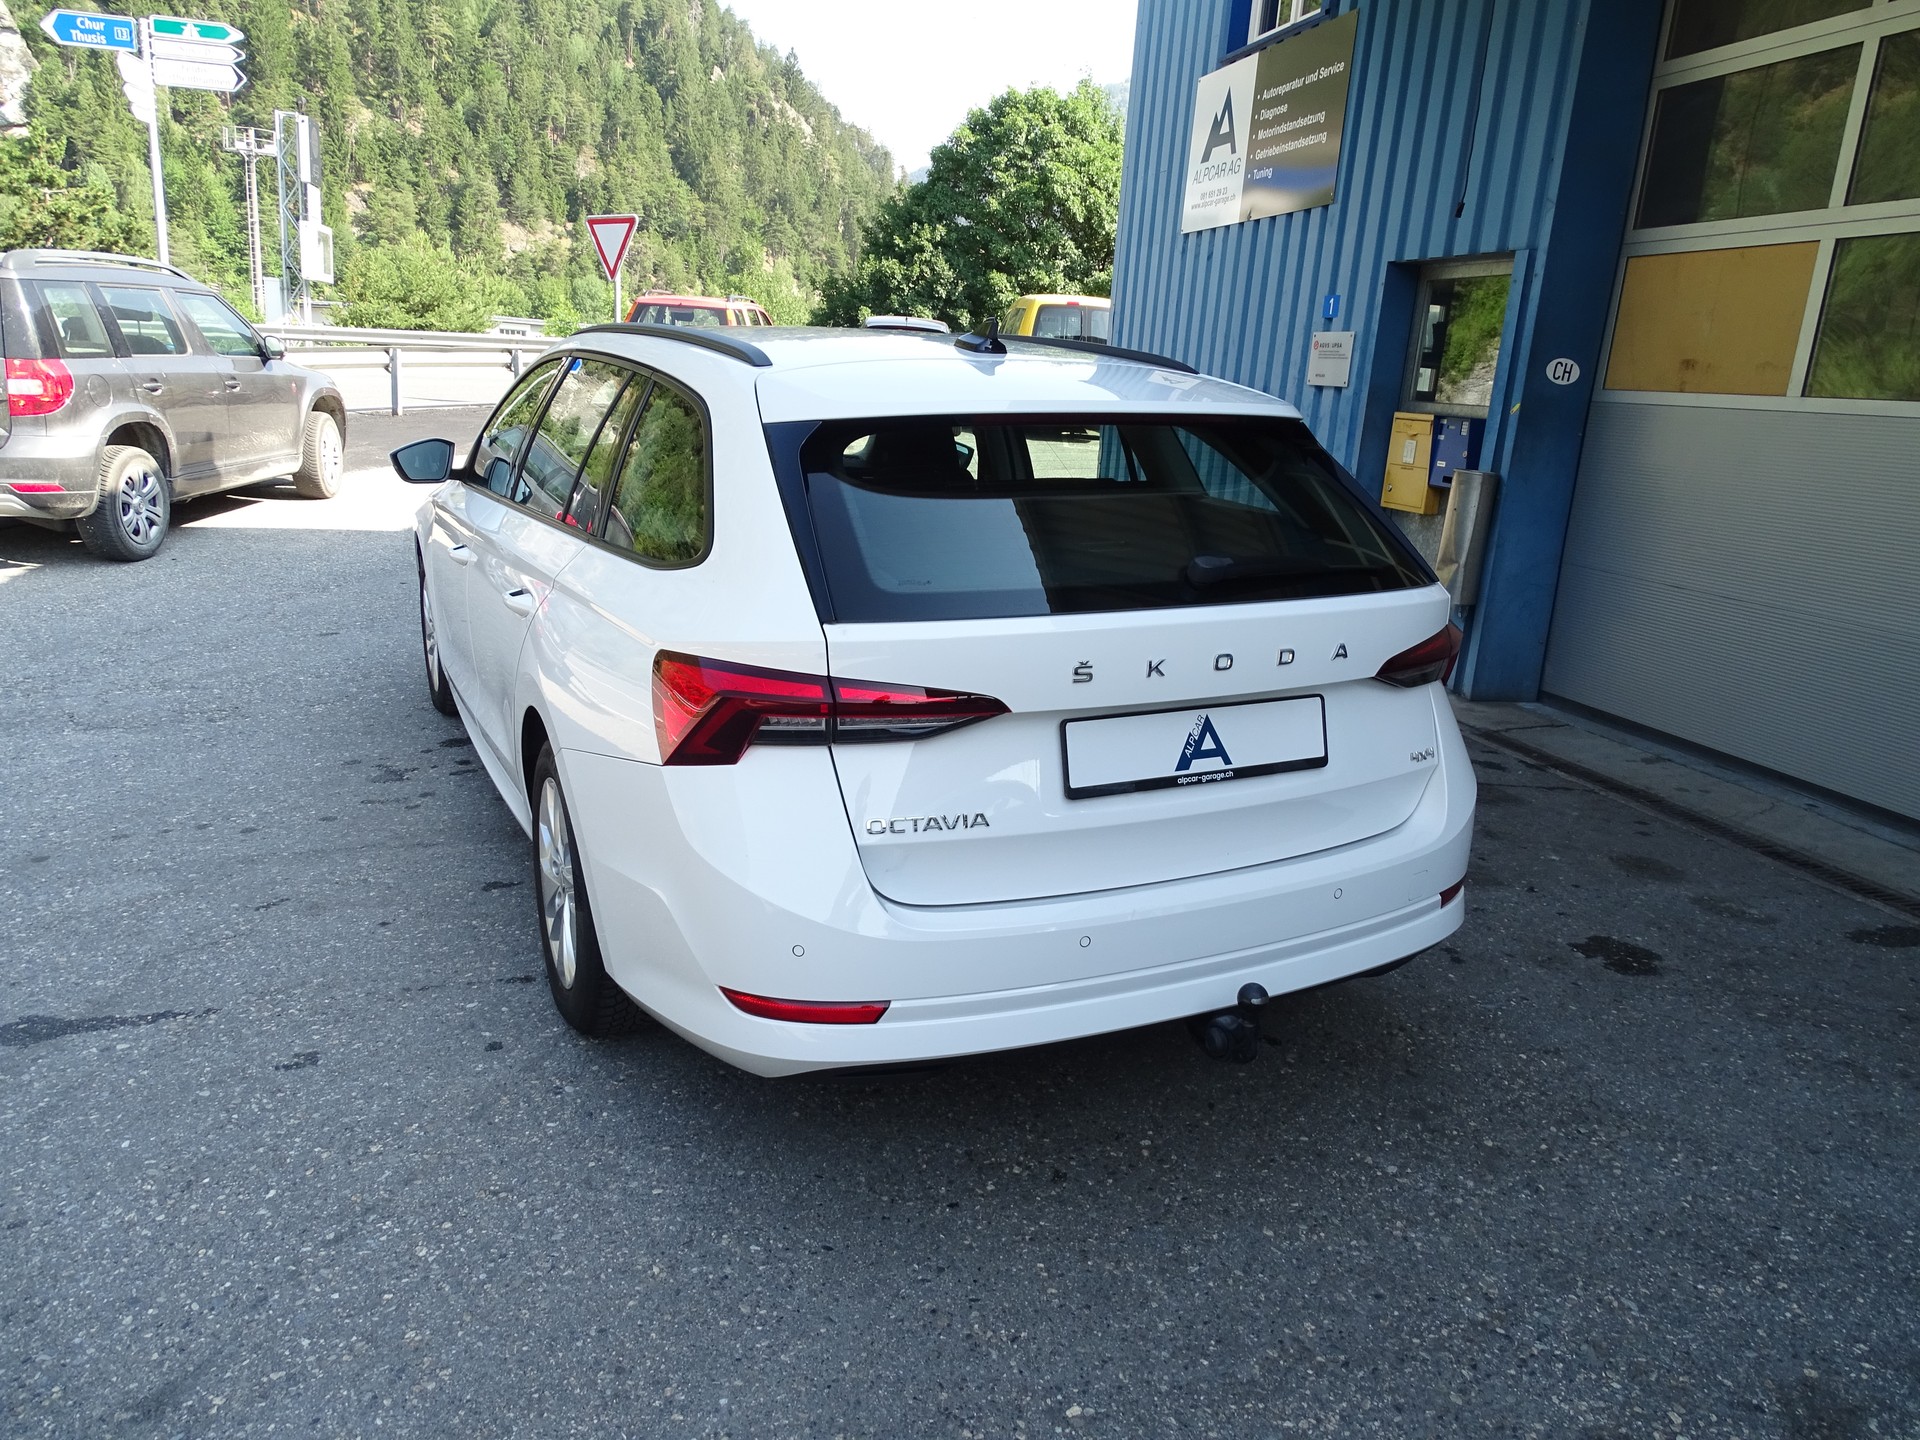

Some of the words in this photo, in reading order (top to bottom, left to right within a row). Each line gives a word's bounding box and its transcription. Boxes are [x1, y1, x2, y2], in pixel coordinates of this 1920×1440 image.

[76, 17, 106, 31] Chur
[70, 29, 107, 45] Thusis
[116, 29, 129, 39] 13
[1262, 77, 1304, 100] Autoreparatur
[1305, 70, 1319, 84] und
[1319, 61, 1345, 79] Service
[1260, 103, 1288, 120] Diagnose
[1257, 111, 1326, 140] Motorindstandsetzung
[1255, 131, 1327, 160] Getriebeinstandsetzung
[1192, 162, 1227, 185] ALPCAR
[1227, 157, 1242, 176] AG
[1253, 167, 1273, 180] Tuning
[1191, 193, 1236, 210] www.alpcar-garage.ch
[1329, 298, 1335, 315] 1
[1552, 361, 1574, 382] CH
[1071, 642, 1349, 683] ŠKODA
[1184, 714, 1205, 758] ALPCAR
[1177, 770, 1234, 785] alpcar-garage.ch
[866, 811, 990, 835] OCTAVIA
